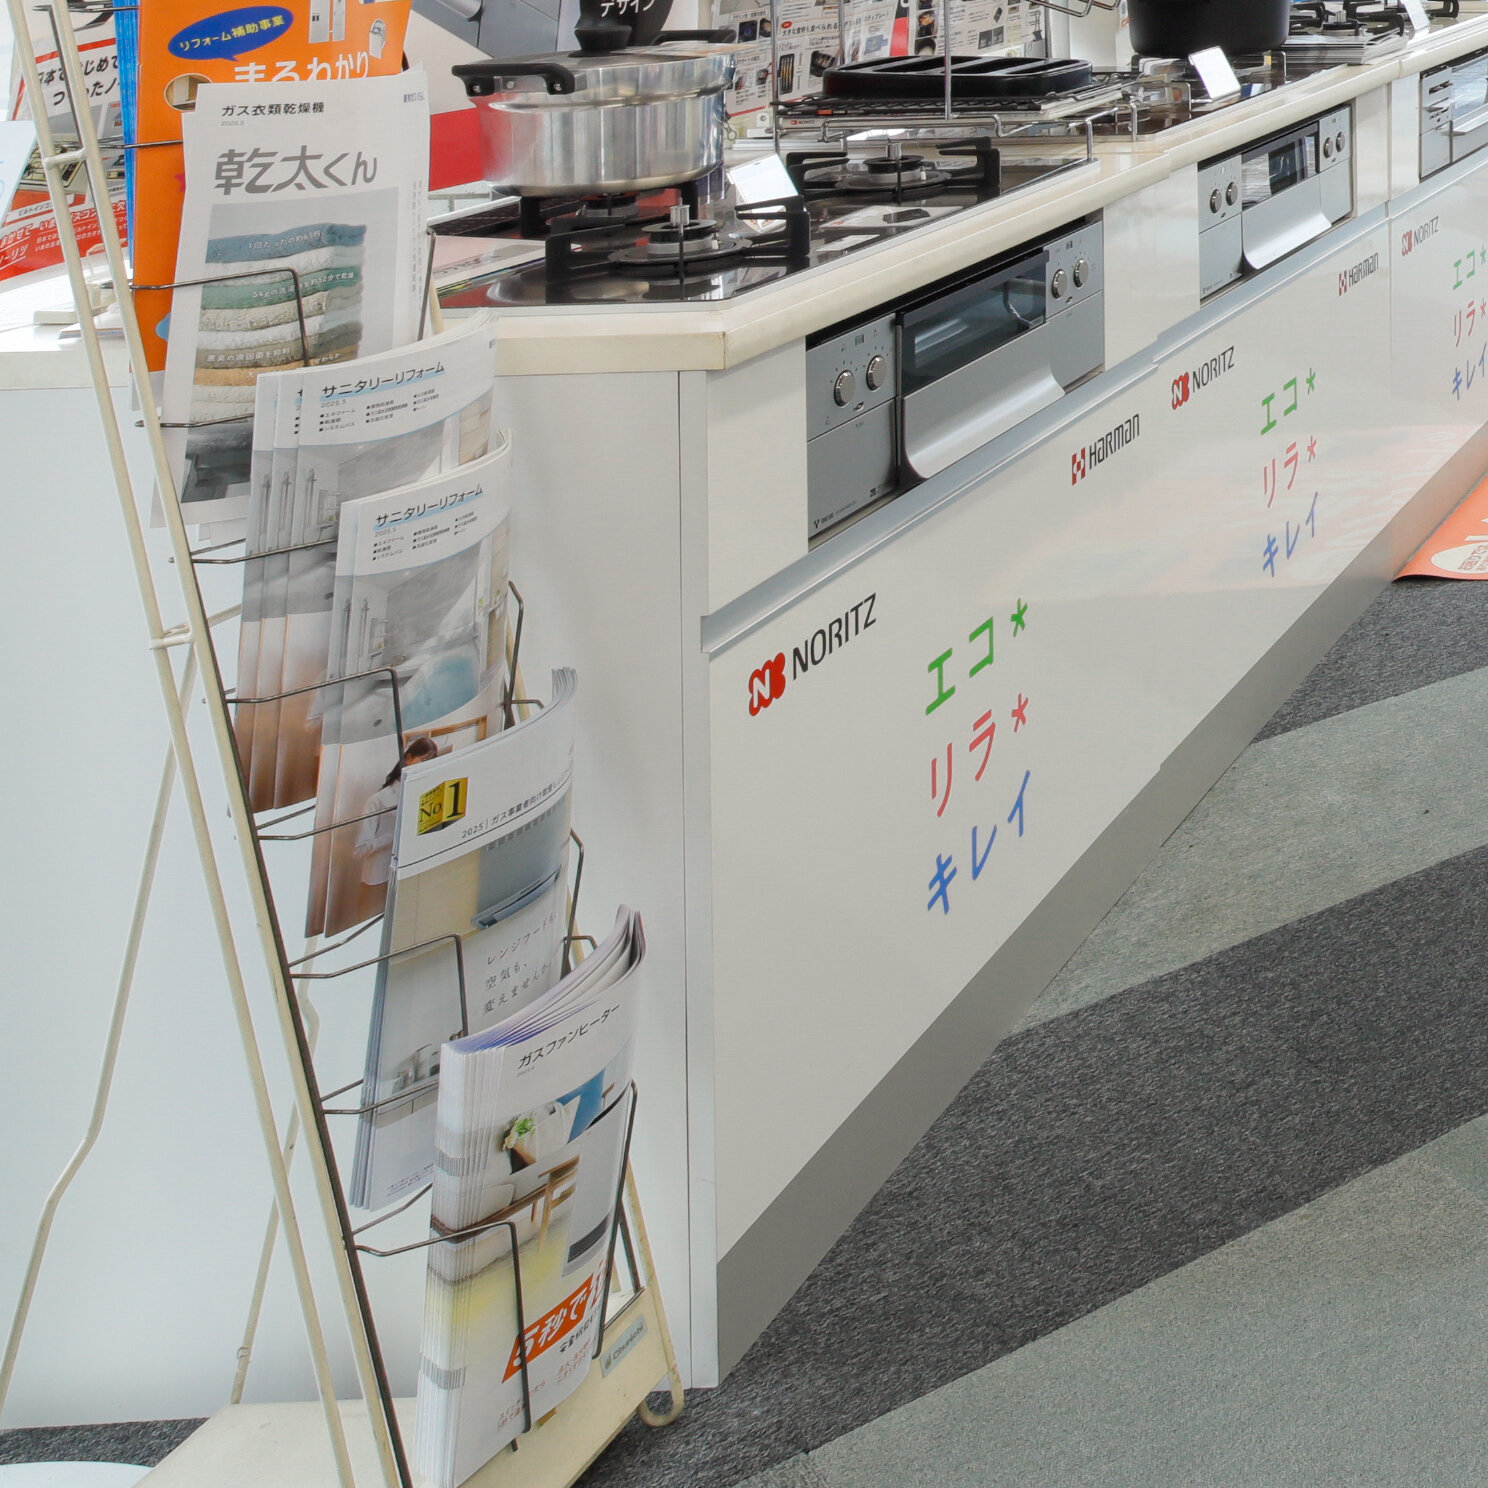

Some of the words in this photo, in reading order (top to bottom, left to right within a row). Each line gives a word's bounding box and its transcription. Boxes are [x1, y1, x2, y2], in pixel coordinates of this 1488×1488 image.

[221, 101, 326, 117] ガス衣類乾燥機
[214, 145, 378, 196] 乾太くん
[1413, 215, 1440, 246] NORITZ
[321, 361, 445, 400] サニタリーリフォーム
[1192, 346, 1235, 394] NORITZ
[1452, 342, 1487, 402] キレイ
[376, 483, 484, 526] サニタリーリフォーム
[1262, 491, 1319, 578] キレイ
[792, 593, 877, 681] NORITZ
[927, 769, 1031, 915] キレイ
[517, 1003, 621, 1070] ガスファンヒーター
